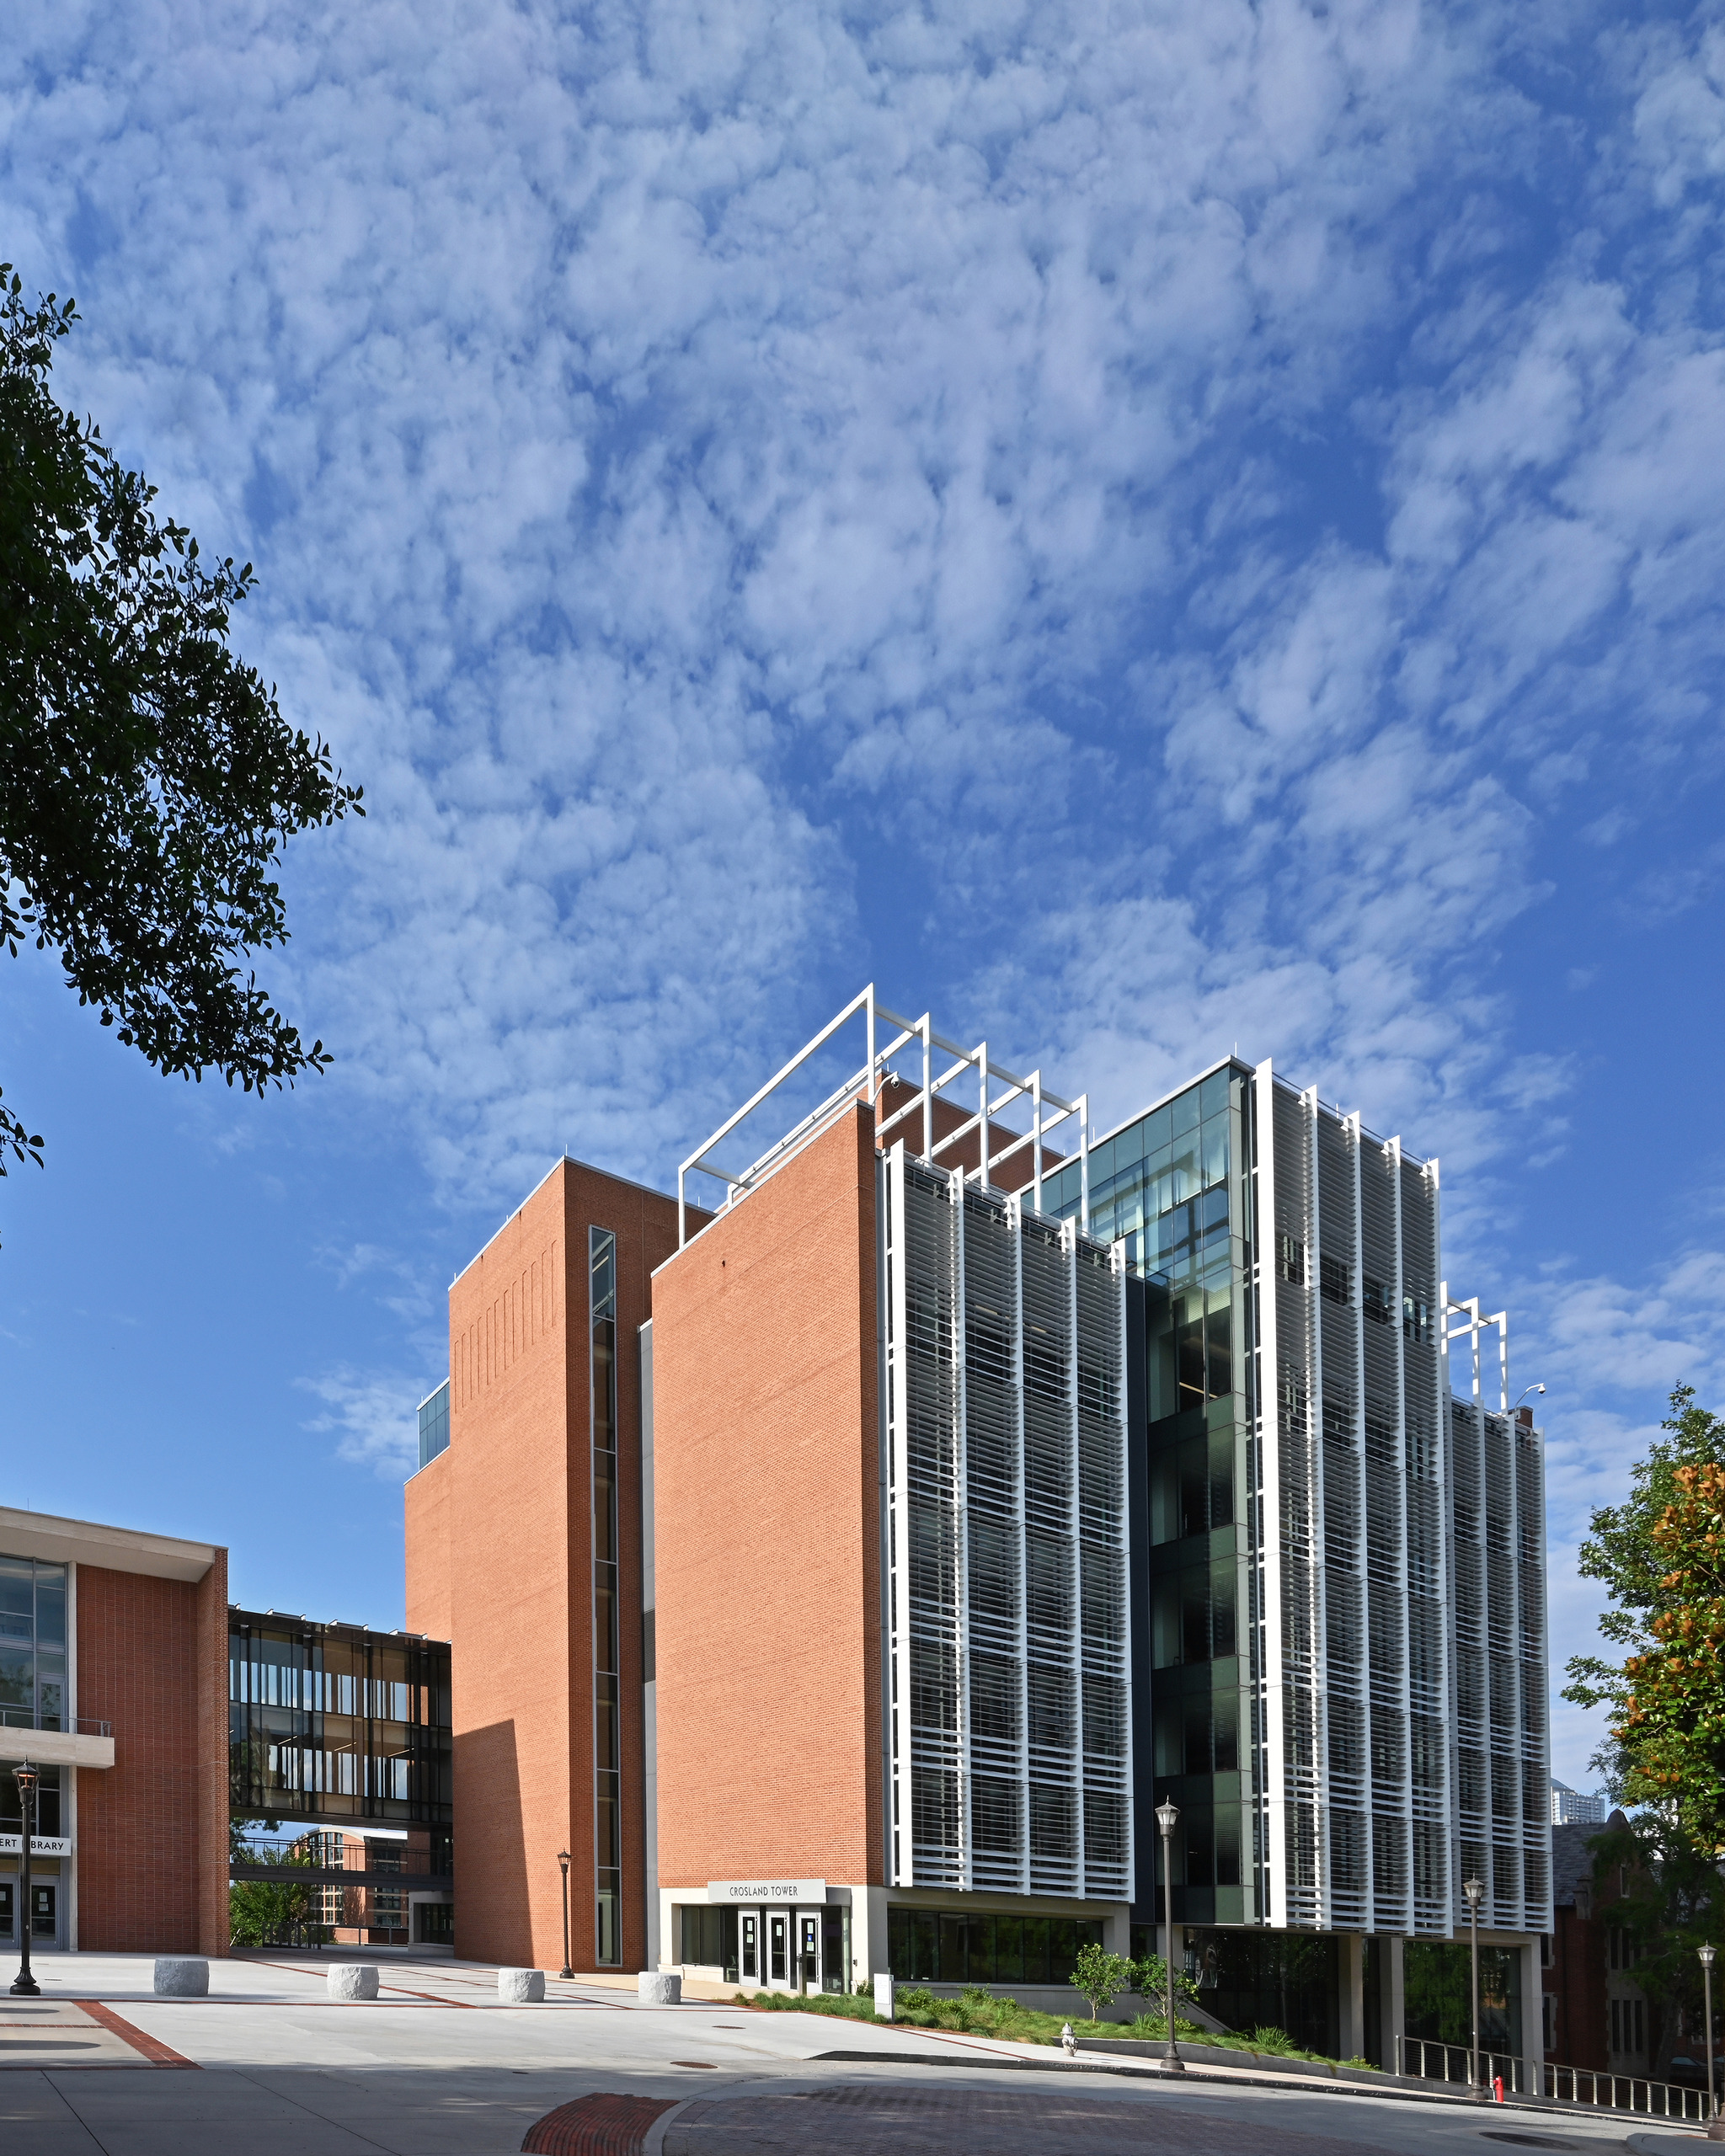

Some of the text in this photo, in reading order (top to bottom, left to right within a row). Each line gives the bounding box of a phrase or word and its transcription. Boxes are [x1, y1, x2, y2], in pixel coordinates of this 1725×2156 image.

[22, 1840, 64, 1850] BRARY
[729, 1886, 798, 1896] CROSLAND TOWER
